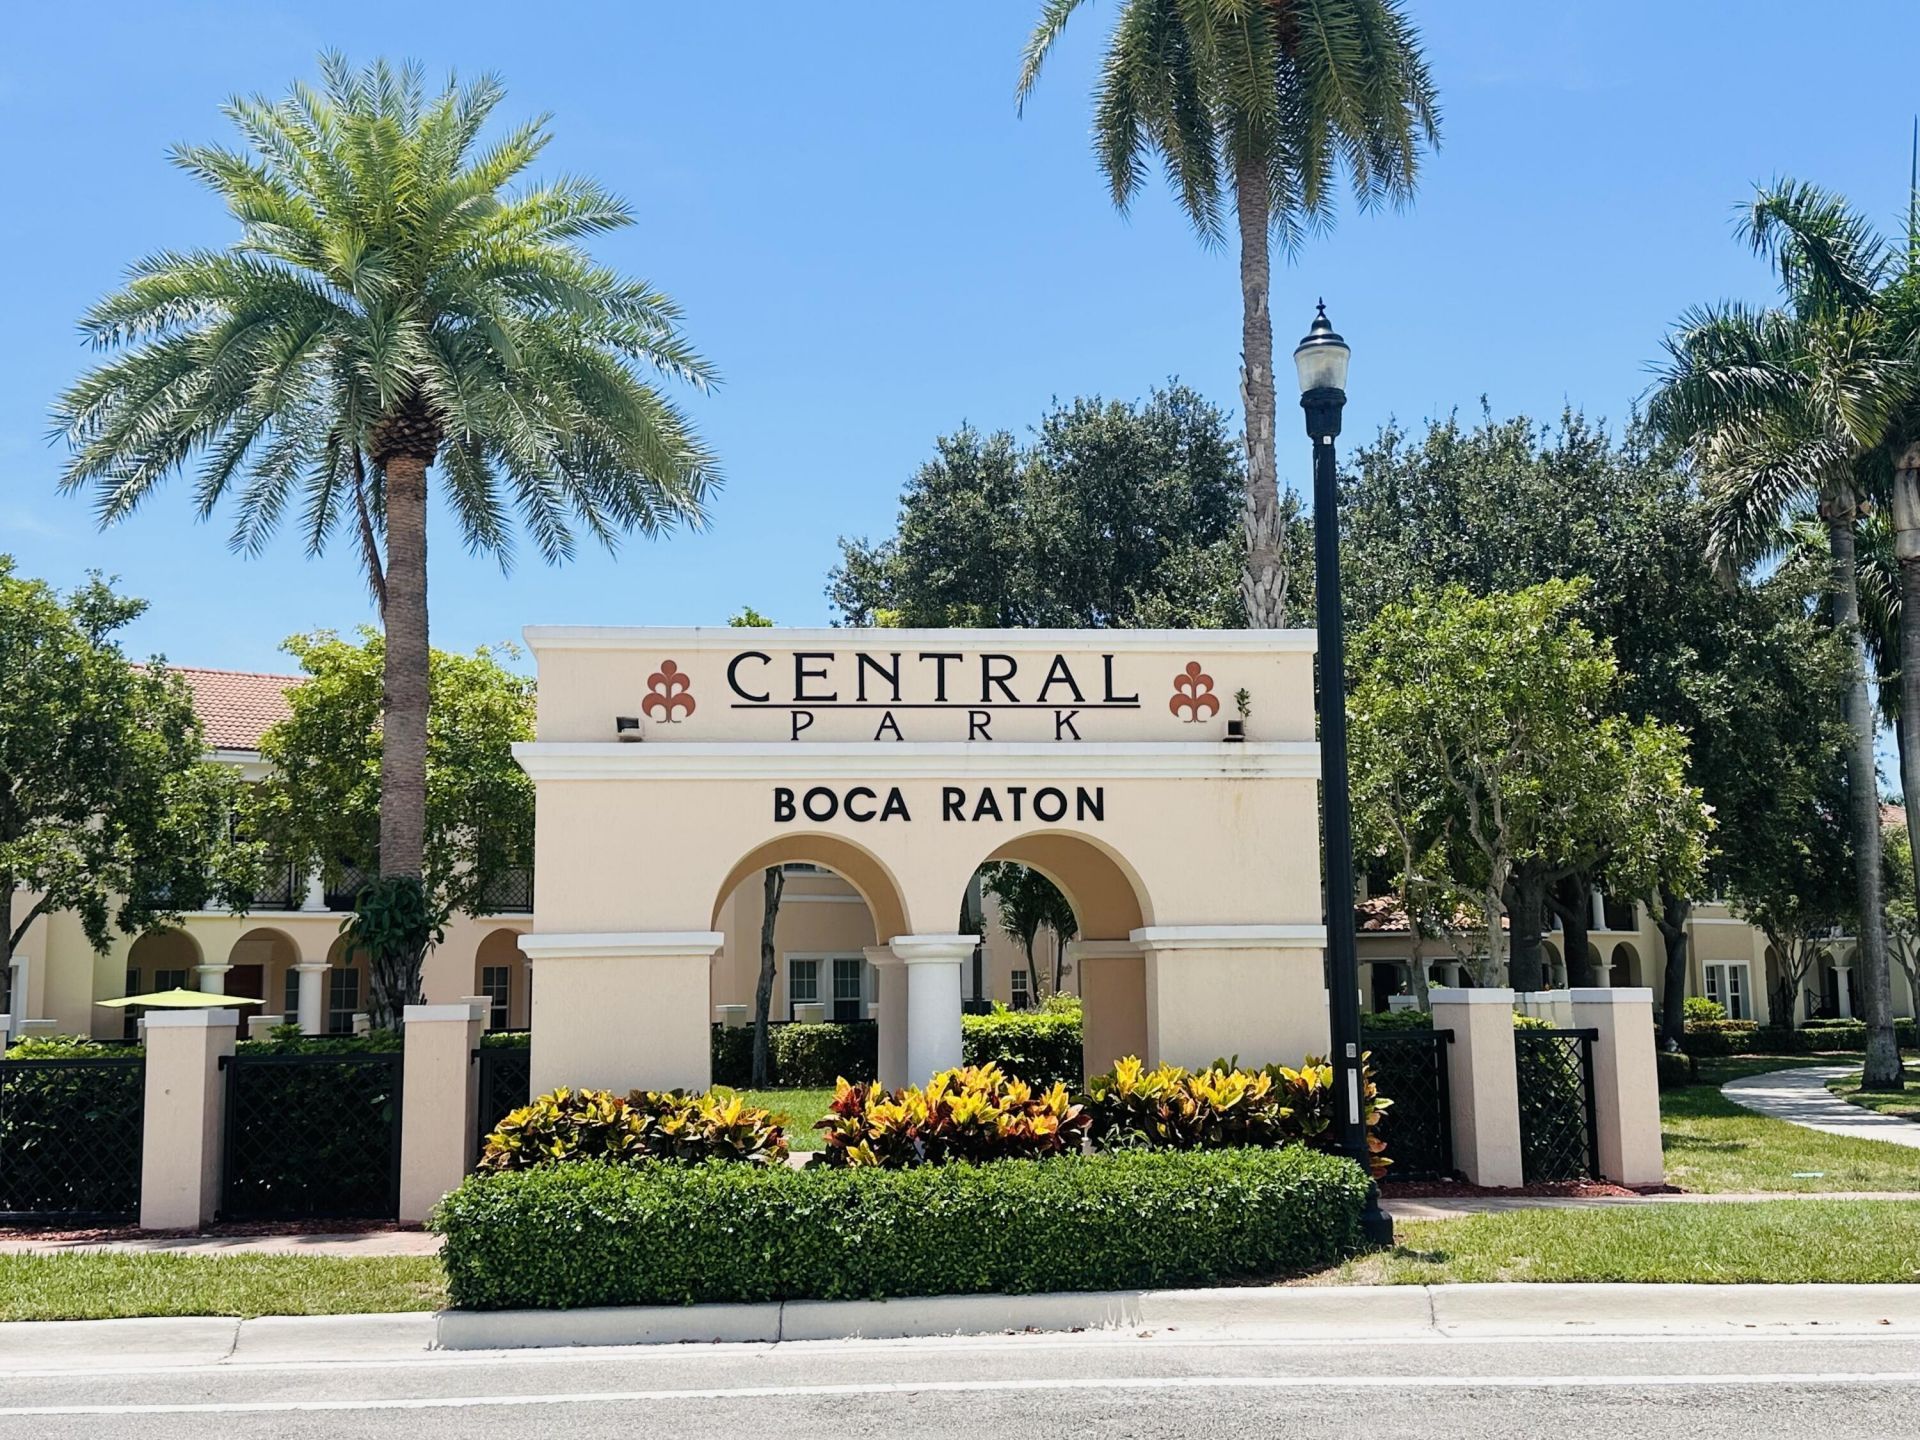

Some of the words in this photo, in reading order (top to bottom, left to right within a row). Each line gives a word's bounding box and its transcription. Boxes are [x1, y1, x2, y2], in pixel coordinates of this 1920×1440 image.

[726, 650, 1141, 704] CENTRAL
[790, 709, 1082, 742] PARK
[774, 786, 912, 823] BOCA
[942, 786, 1105, 823] RATON
